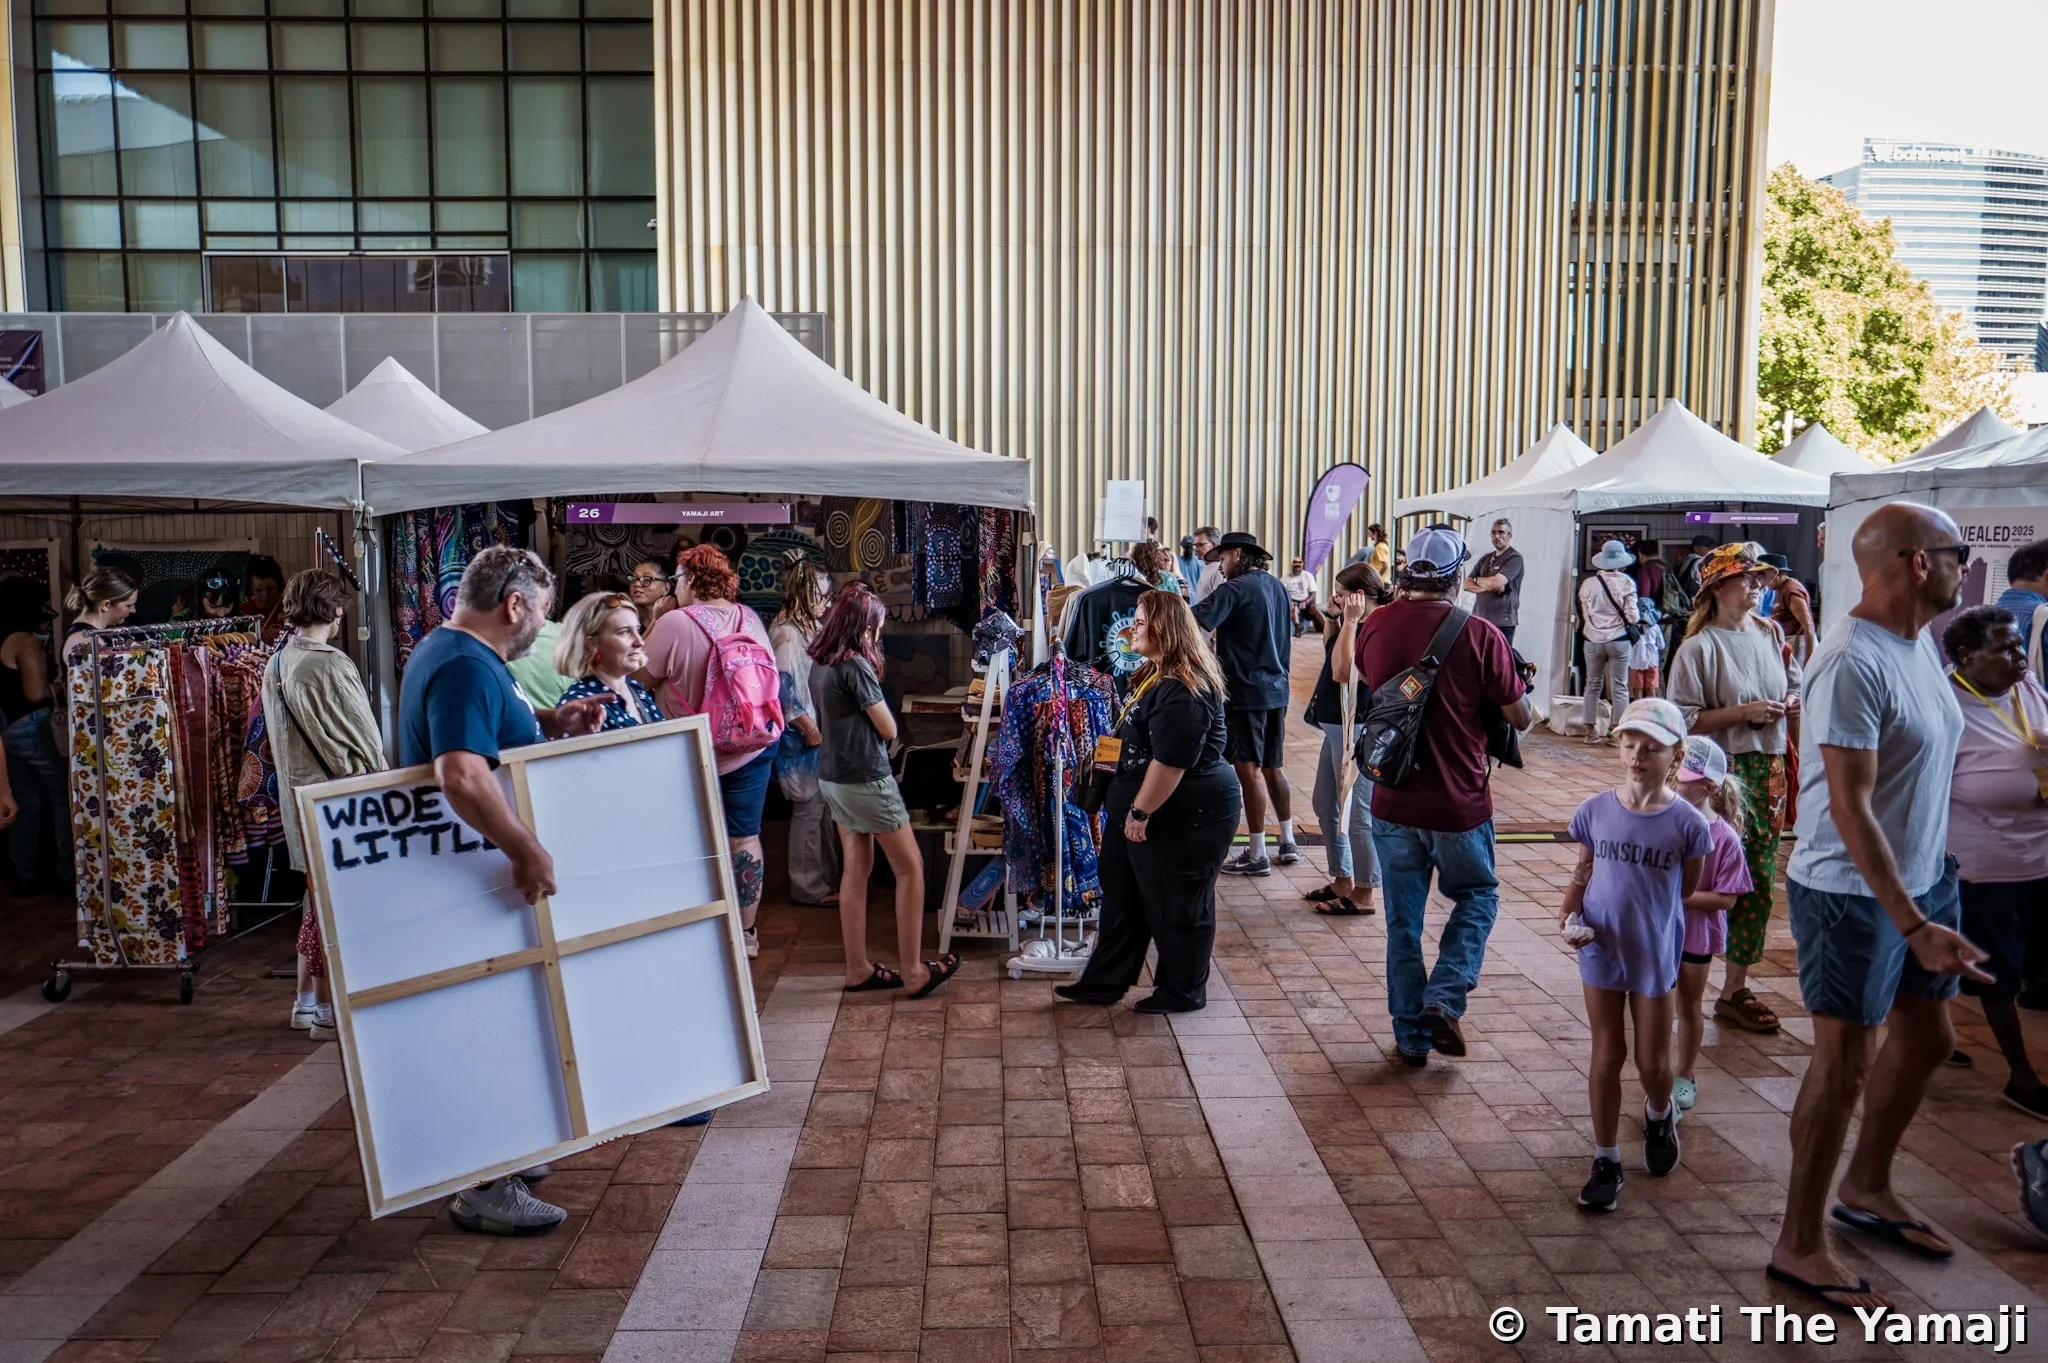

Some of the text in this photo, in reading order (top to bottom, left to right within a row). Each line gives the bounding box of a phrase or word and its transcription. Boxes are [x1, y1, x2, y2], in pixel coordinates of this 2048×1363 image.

[578, 508, 601, 518] 26
[1959, 525, 2034, 541] VEALED 2025
[322, 785, 443, 830] WADE
[1595, 840, 1673, 870] LONSDALE
